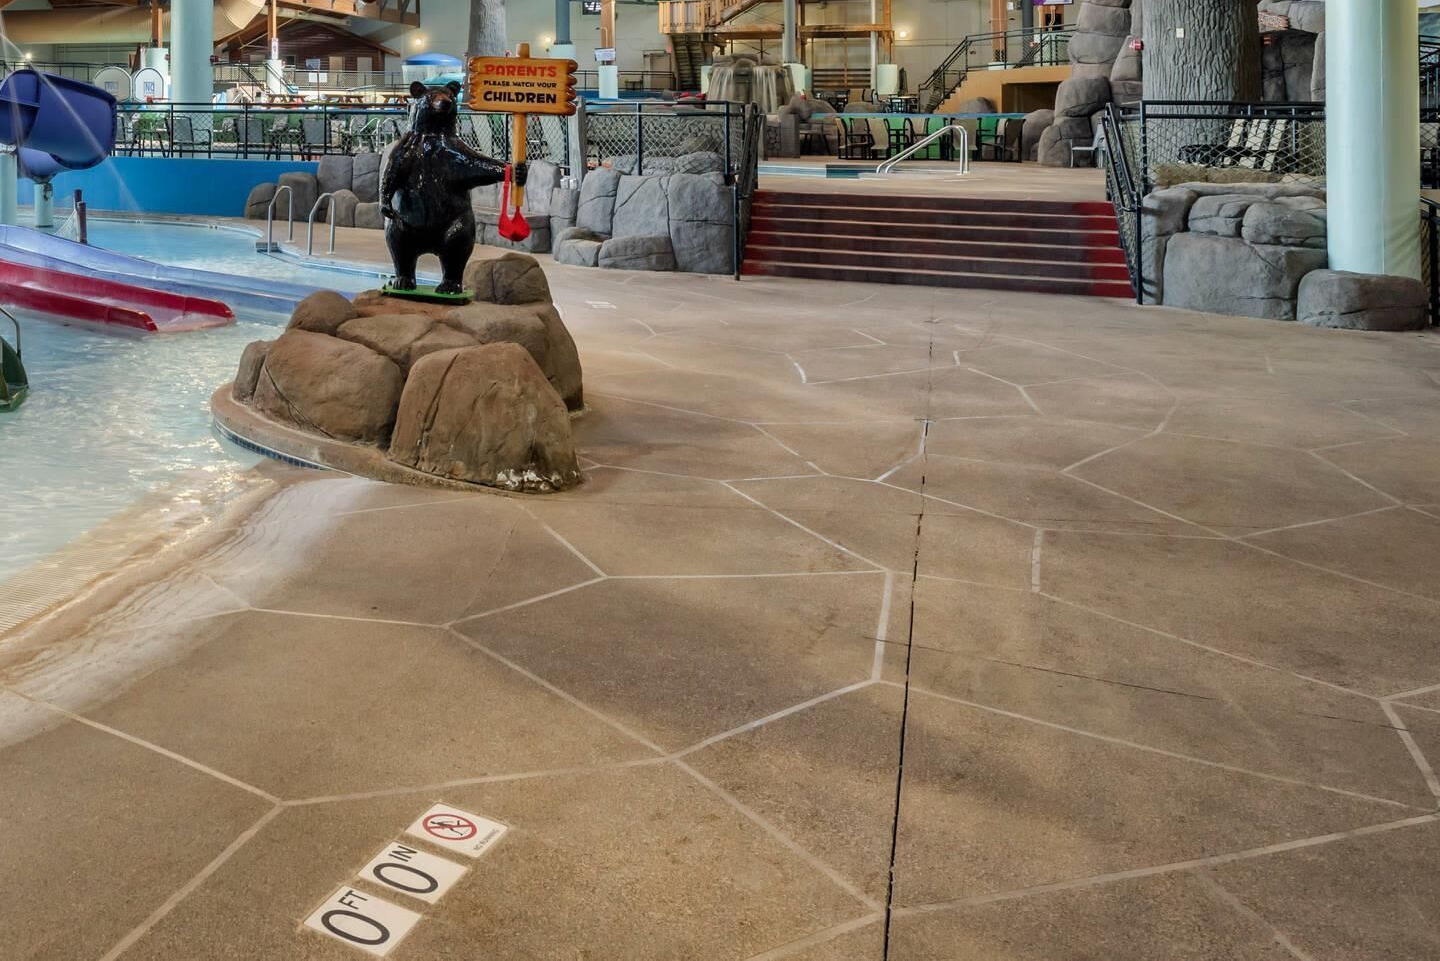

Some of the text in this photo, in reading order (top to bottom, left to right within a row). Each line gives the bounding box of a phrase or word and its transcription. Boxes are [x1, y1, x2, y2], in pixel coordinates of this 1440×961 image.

[484, 64, 558, 78] PARENTS
[483, 90, 557, 104] CHILDREN
[338, 890, 368, 910] FT
[388, 845, 418, 863] IN
